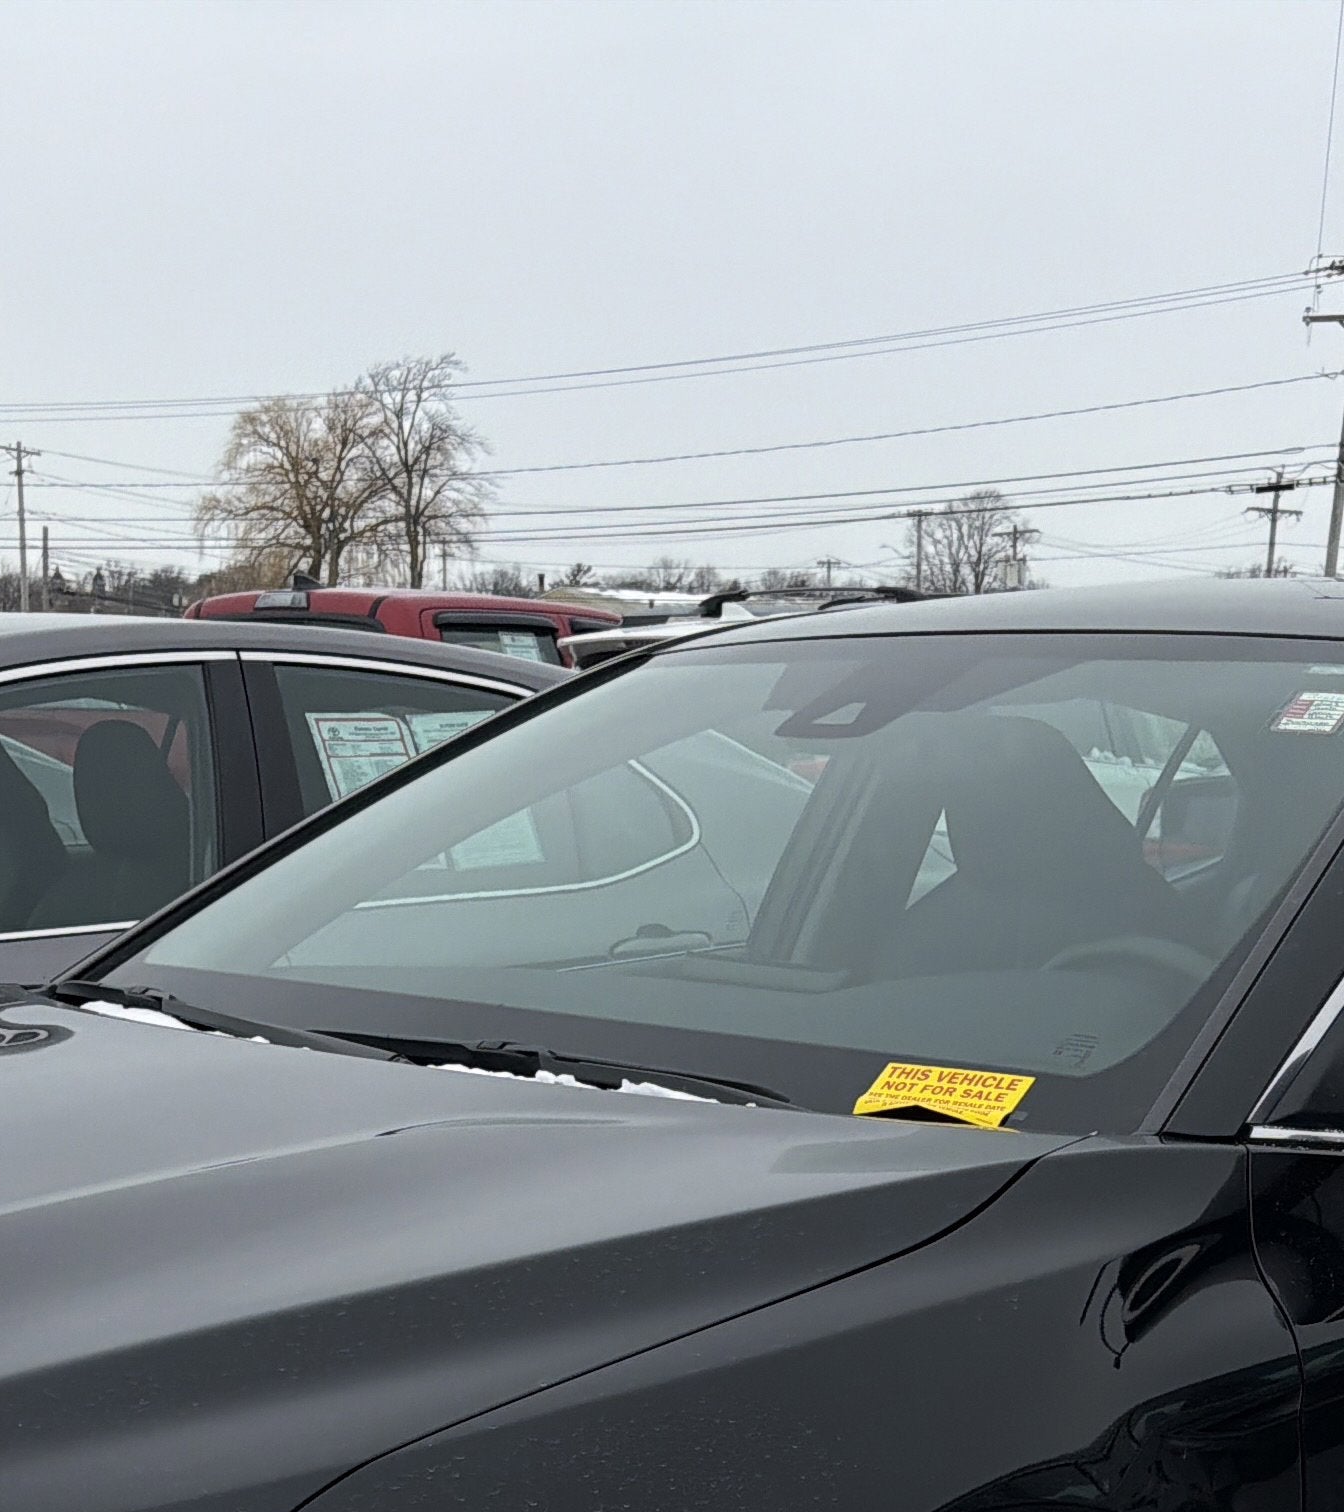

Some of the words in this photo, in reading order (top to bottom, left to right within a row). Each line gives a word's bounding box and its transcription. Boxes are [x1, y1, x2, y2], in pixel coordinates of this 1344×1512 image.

[888, 1066, 932, 1082] THIS
[936, 1071, 1024, 1092] VEHICLE
[880, 1080, 919, 1092] NOT
[919, 1084, 958, 1097] FOR
[960, 1088, 1009, 1103] SALE
[901, 1095, 933, 1103] DEALER
[984, 1104, 1007, 1112] DATE
